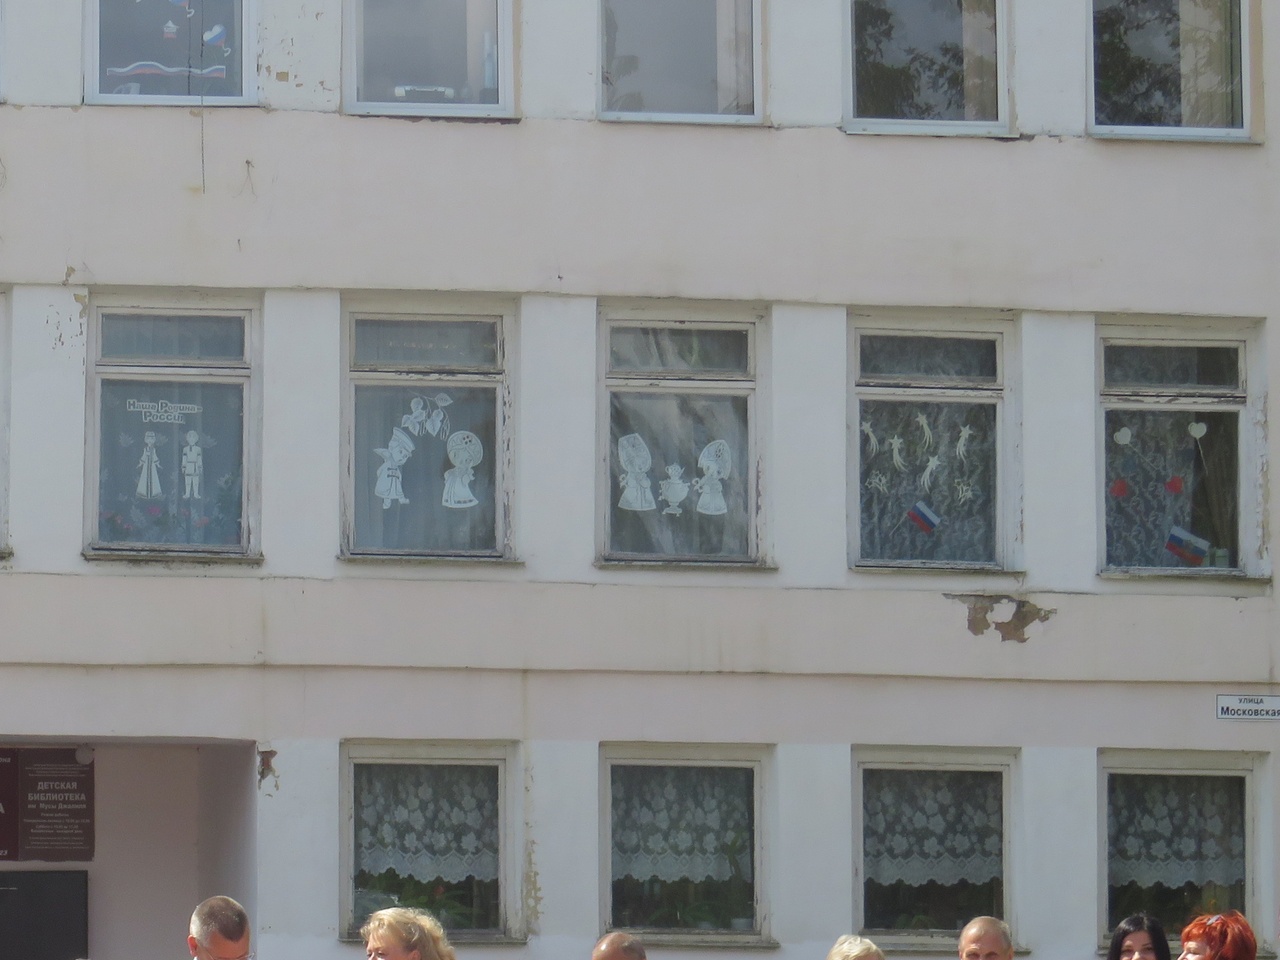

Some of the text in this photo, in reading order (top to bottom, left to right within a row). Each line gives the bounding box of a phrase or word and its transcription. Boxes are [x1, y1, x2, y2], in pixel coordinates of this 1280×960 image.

[127, 399, 157, 411] Наша
[1238, 697, 1264, 705] УЛИЦА
[37, 781, 77, 790] ДЕТСКАЯ
[27, 793, 86, 801] БИБЛИОТЕКА
